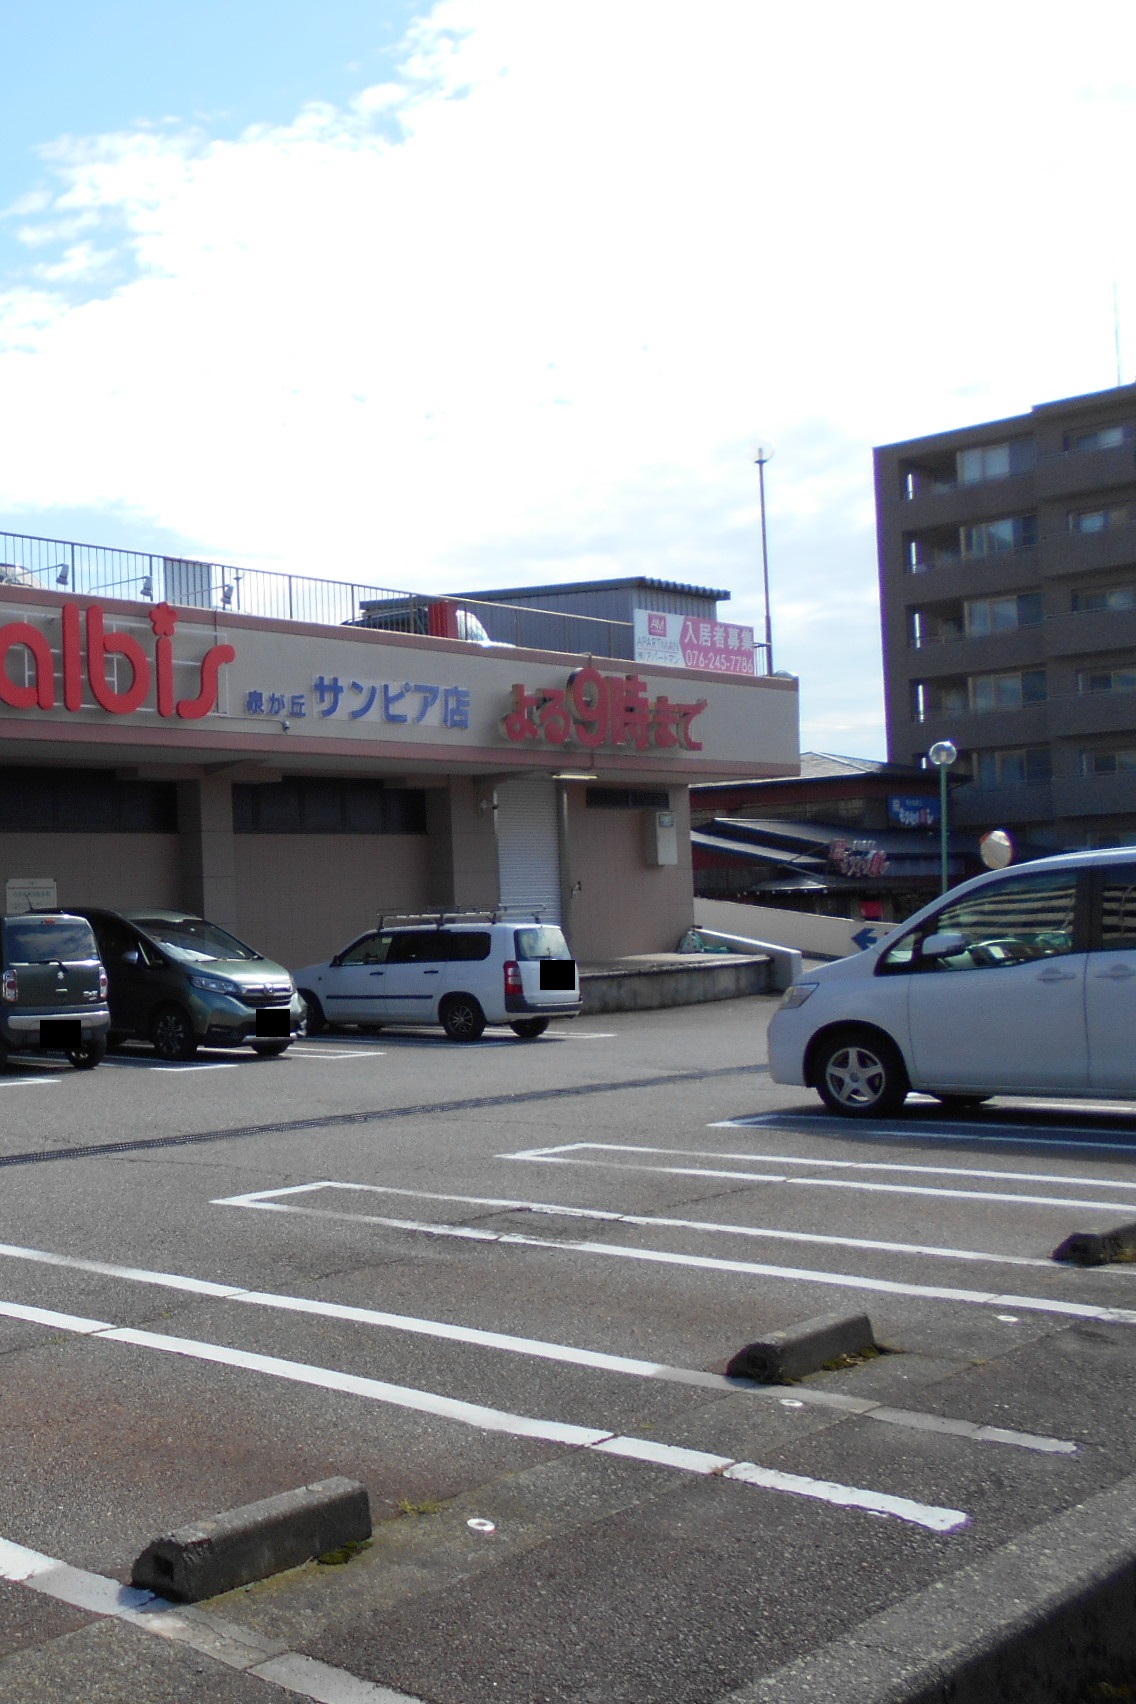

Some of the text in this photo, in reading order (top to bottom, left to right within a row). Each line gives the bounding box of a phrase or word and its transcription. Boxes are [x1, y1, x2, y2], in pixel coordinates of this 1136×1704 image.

[685, 621, 753, 651] 入居者募集
[686, 650, 753, 673] 076-245-7786
[246, 676, 471, 729] 泉が丘 サンピア店
